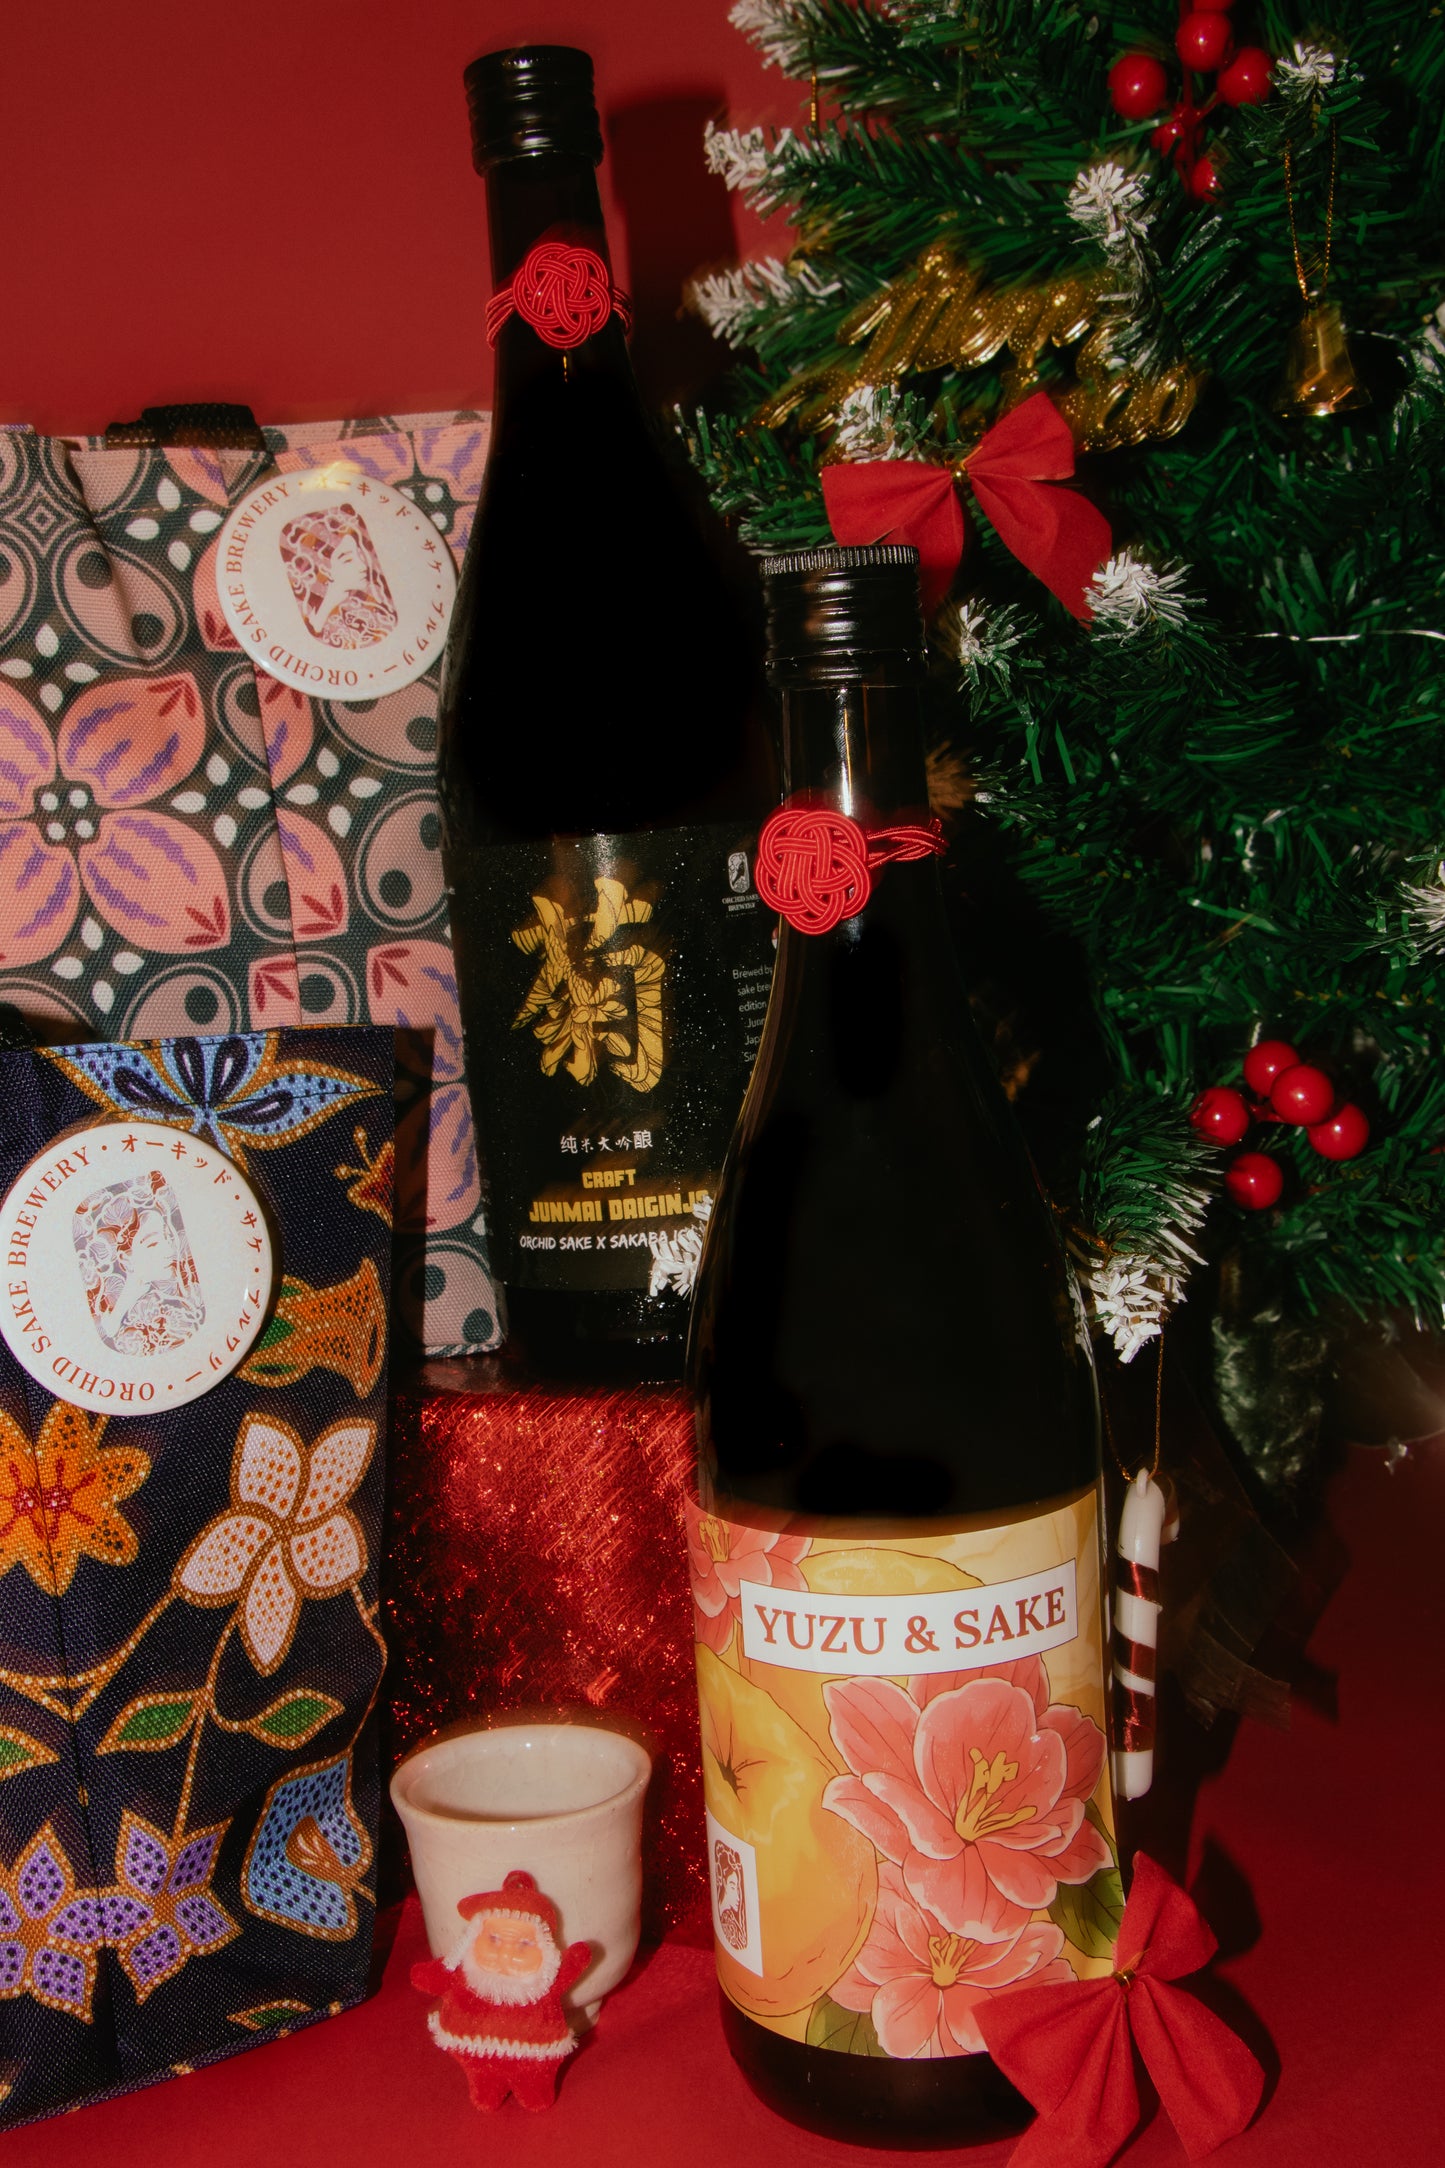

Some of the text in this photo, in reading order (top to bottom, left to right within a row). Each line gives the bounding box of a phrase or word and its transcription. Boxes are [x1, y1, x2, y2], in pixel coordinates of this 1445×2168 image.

[225, 481, 359, 687] ORCHID SAKE BREWERY
[732, 967, 763, 980] Brewed
[737, 984, 755, 996] sake
[738, 1000, 767, 1013] edition
[744, 1035, 761, 1047] Jap
[743, 1051, 757, 1063] Sin
[582, 1168, 636, 1189] CRAFT
[529, 1200, 603, 1223] JUNMAI
[520, 1235, 557, 1251] ORCHID
[559, 1234, 592, 1251] SAKE
[596, 1235, 606, 1250] X
[609, 1230, 668, 1250] SAKABA
[7, 1145, 156, 1402] ORCHID SAKE BREWERY
[754, 1586, 1066, 1655] YUZU & SAKE
